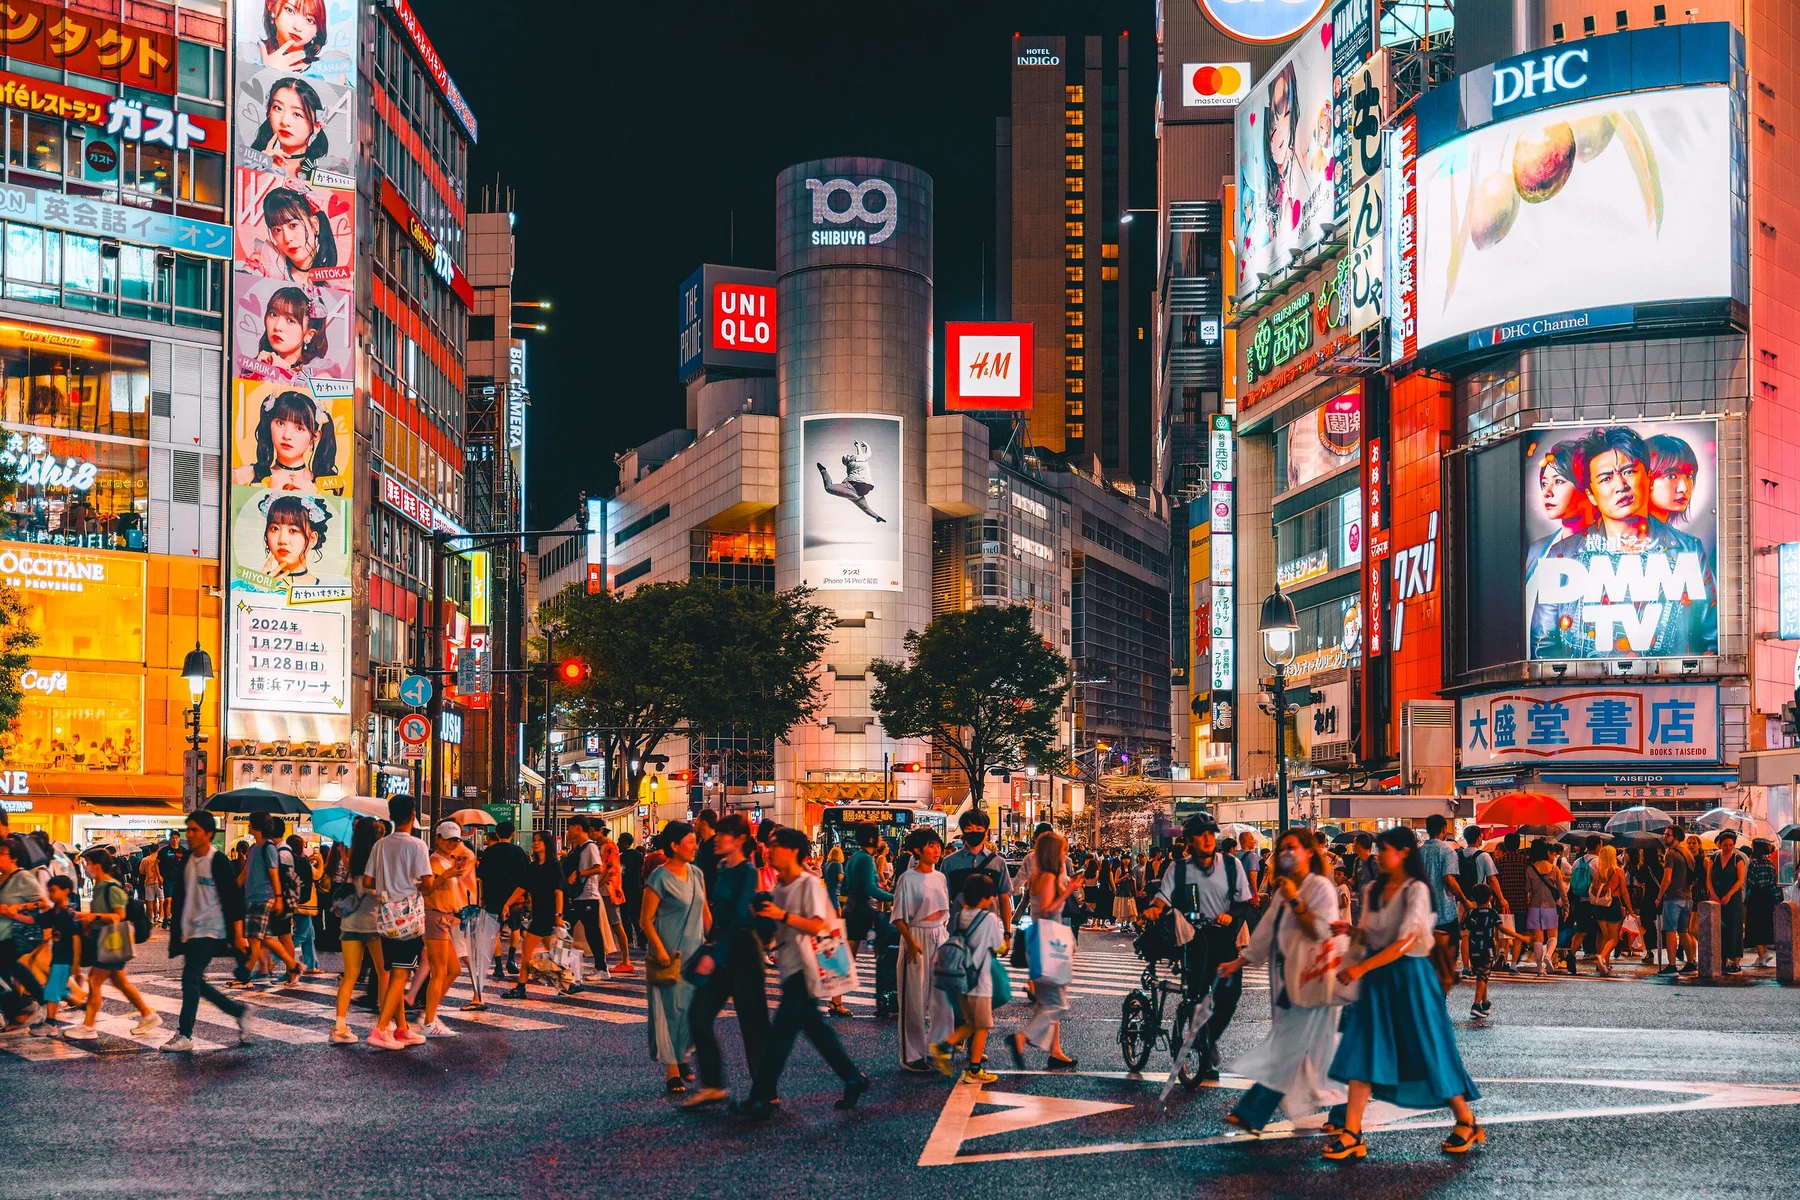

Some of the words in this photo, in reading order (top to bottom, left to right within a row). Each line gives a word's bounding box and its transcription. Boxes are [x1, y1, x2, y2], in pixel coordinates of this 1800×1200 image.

[0, 4, 170, 76] ンタクト
[1017, 56, 1060, 65] INDIGO
[1493, 49, 1588, 107] DHC
[107, 99, 206, 150] ガスト
[89, 152, 114, 165] ガスト
[243, 150, 269, 166] JULIA
[316, 173, 350, 185] かわいい
[1353, 69, 1383, 315] もんじゃ
[44, 196, 226, 249] 英会話イーオン
[806, 178, 898, 245] 109
[812, 231, 866, 245] SHIBUYA
[315, 268, 349, 280] HITOKA
[685, 284, 698, 326] THE
[721, 291, 766, 317] UNI
[721, 319, 770, 345] QLO
[1501, 323, 1530, 342] DHC
[1532, 313, 1589, 335] Channel
[681, 319, 702, 368] PRIME
[243, 357, 276, 377] HARUKA
[509, 347, 522, 376] BIC
[969, 352, 1012, 379] H&M
[315, 382, 349, 393] かわいい
[509, 377, 523, 448] CAMERA
[322, 478, 338, 487] AKI
[0, 551, 105, 581] OCCITANE
[241, 568, 273, 587] HIYORI
[1527, 552, 1707, 605] DMM
[6, 577, 20, 587] EN
[25, 579, 84, 592] PROVENCE
[823, 577, 844, 585] iPhone
[1783, 547, 1799, 635] 大盛堂商事ビル
[251, 618, 299, 633] 2024年
[1583, 603, 1663, 652] TV
[251, 636, 325, 653] 1月27日(土)
[251, 655, 325, 672] 1月28日(日)
[465, 651, 475, 692] 渋谷駅前
[21, 669, 68, 695] Café
[250, 676, 332, 694] 横浜アリーナ
[440, 711, 461, 744] USH
[1468, 698, 1697, 751] 大盛堂書店
[1649, 748, 1673, 756] BOOKS
[1675, 748, 1707, 756] TAISEIDO
[241, 763, 349, 777] 渋谷駅前ビル
[1622, 788, 1685, 797] 大盛堂書店
[128, 817, 147, 825] ploom
